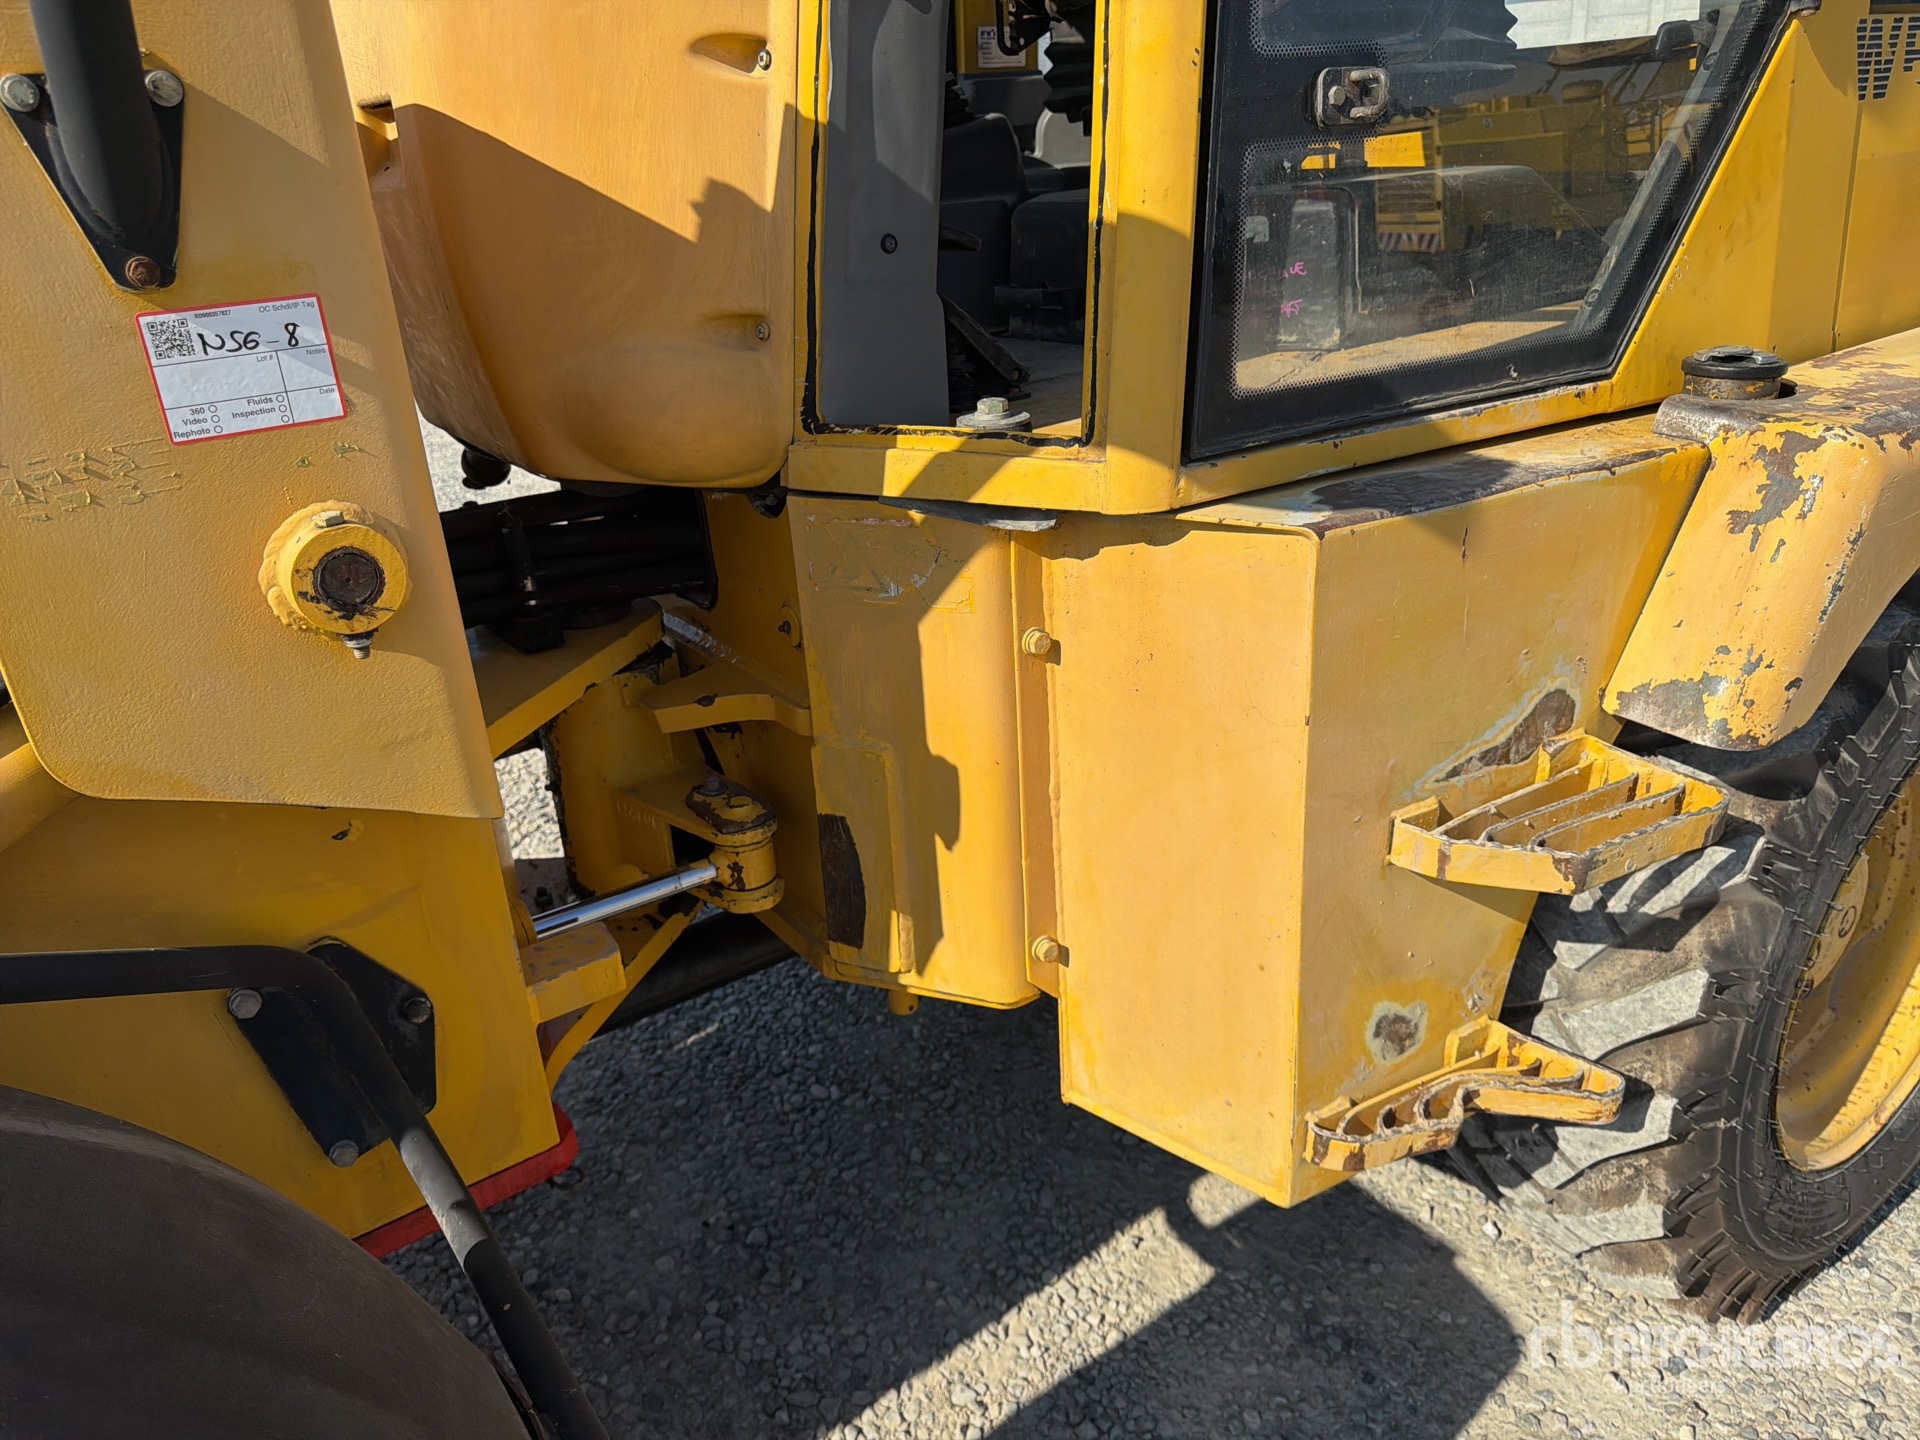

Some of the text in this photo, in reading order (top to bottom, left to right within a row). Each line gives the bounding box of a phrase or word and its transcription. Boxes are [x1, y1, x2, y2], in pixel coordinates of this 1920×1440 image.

[258, 304, 271, 314] OC
[301, 301, 315, 309] Tag
[305, 347, 326, 356] Notes
[256, 355, 268, 363] Lot
[319, 387, 335, 395] Date
[246, 396, 274, 407] Fluids
[189, 407, 206, 416] 360
[231, 407, 277, 420] Inspection
[181, 417, 208, 427] Video
[173, 427, 211, 440] Rephoto
